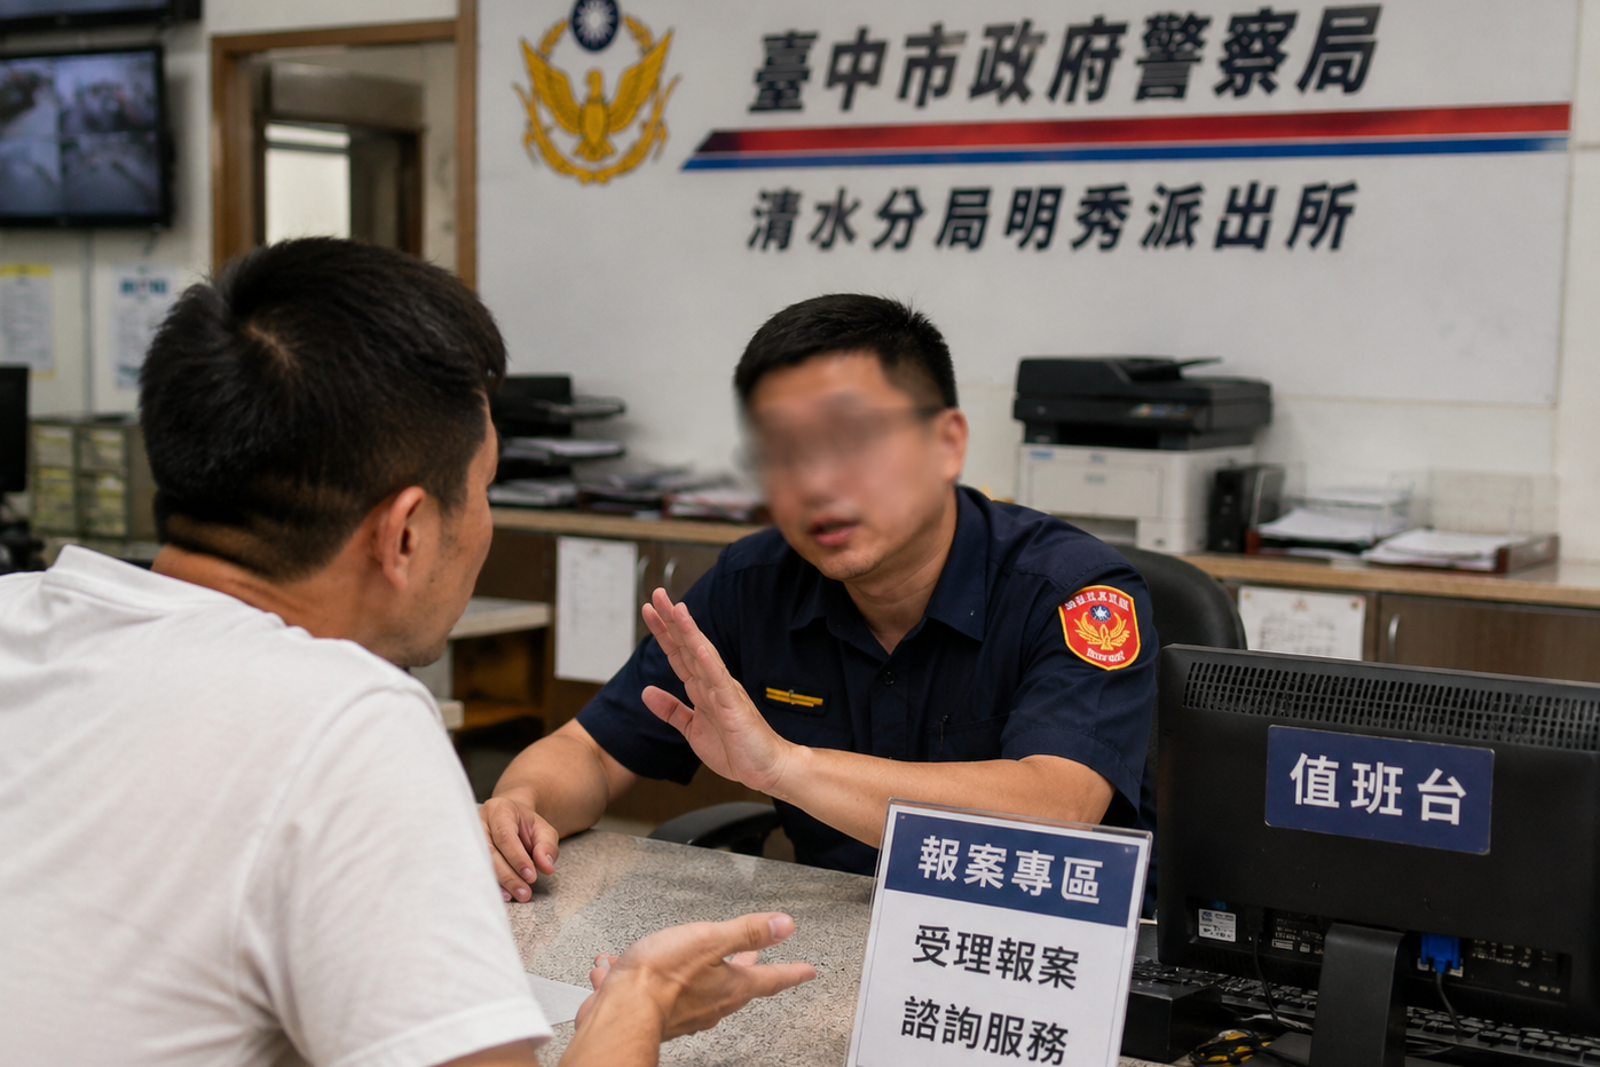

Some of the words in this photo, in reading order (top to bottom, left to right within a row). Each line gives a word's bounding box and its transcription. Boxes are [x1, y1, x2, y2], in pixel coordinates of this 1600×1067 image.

[747, 4, 1383, 115] 臺中市政府警察局
[747, 180, 1360, 253] 清水分局明秀派出所
[1289, 752, 1467, 826] 值班台
[918, 835, 1103, 904] 報案專區
[912, 924, 1079, 990] 受理報案
[901, 995, 1069, 1067] 諮詢服務
